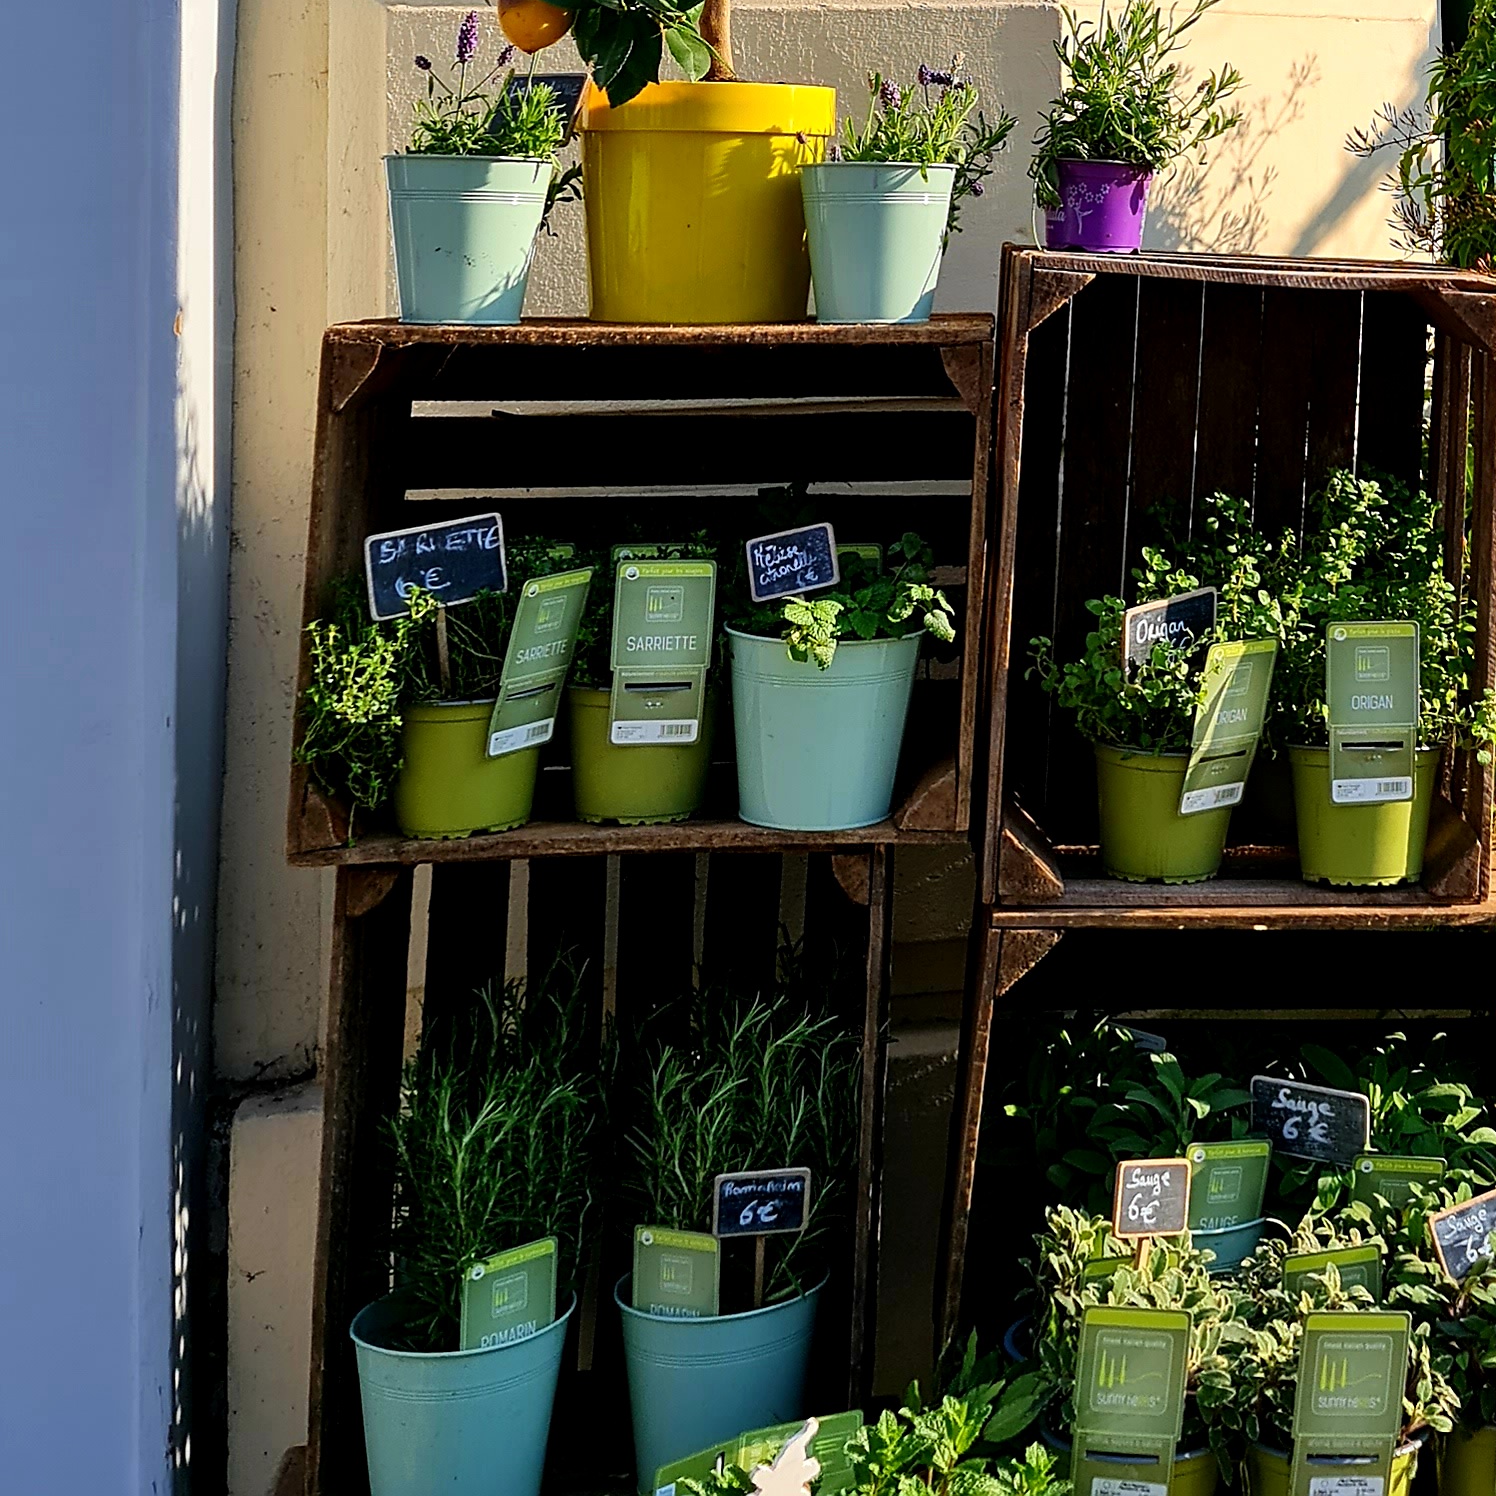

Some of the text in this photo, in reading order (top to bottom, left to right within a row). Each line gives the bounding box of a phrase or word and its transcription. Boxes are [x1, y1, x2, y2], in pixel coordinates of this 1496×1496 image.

[516, 639, 568, 665] SARRIETTE
[626, 635, 697, 652] SARRIETTE
[1351, 694, 1393, 710] ORIGAN
[1216, 708, 1248, 726] ORIGAN
[1272, 1087, 1336, 1128] Sauge
[1126, 1167, 1171, 1196] Sauge
[740, 1199, 779, 1226] 6€
[1128, 1192, 1160, 1224] 6€
[1445, 1209, 1488, 1239] Sauge
[481, 1320, 536, 1348] ROMARIN
